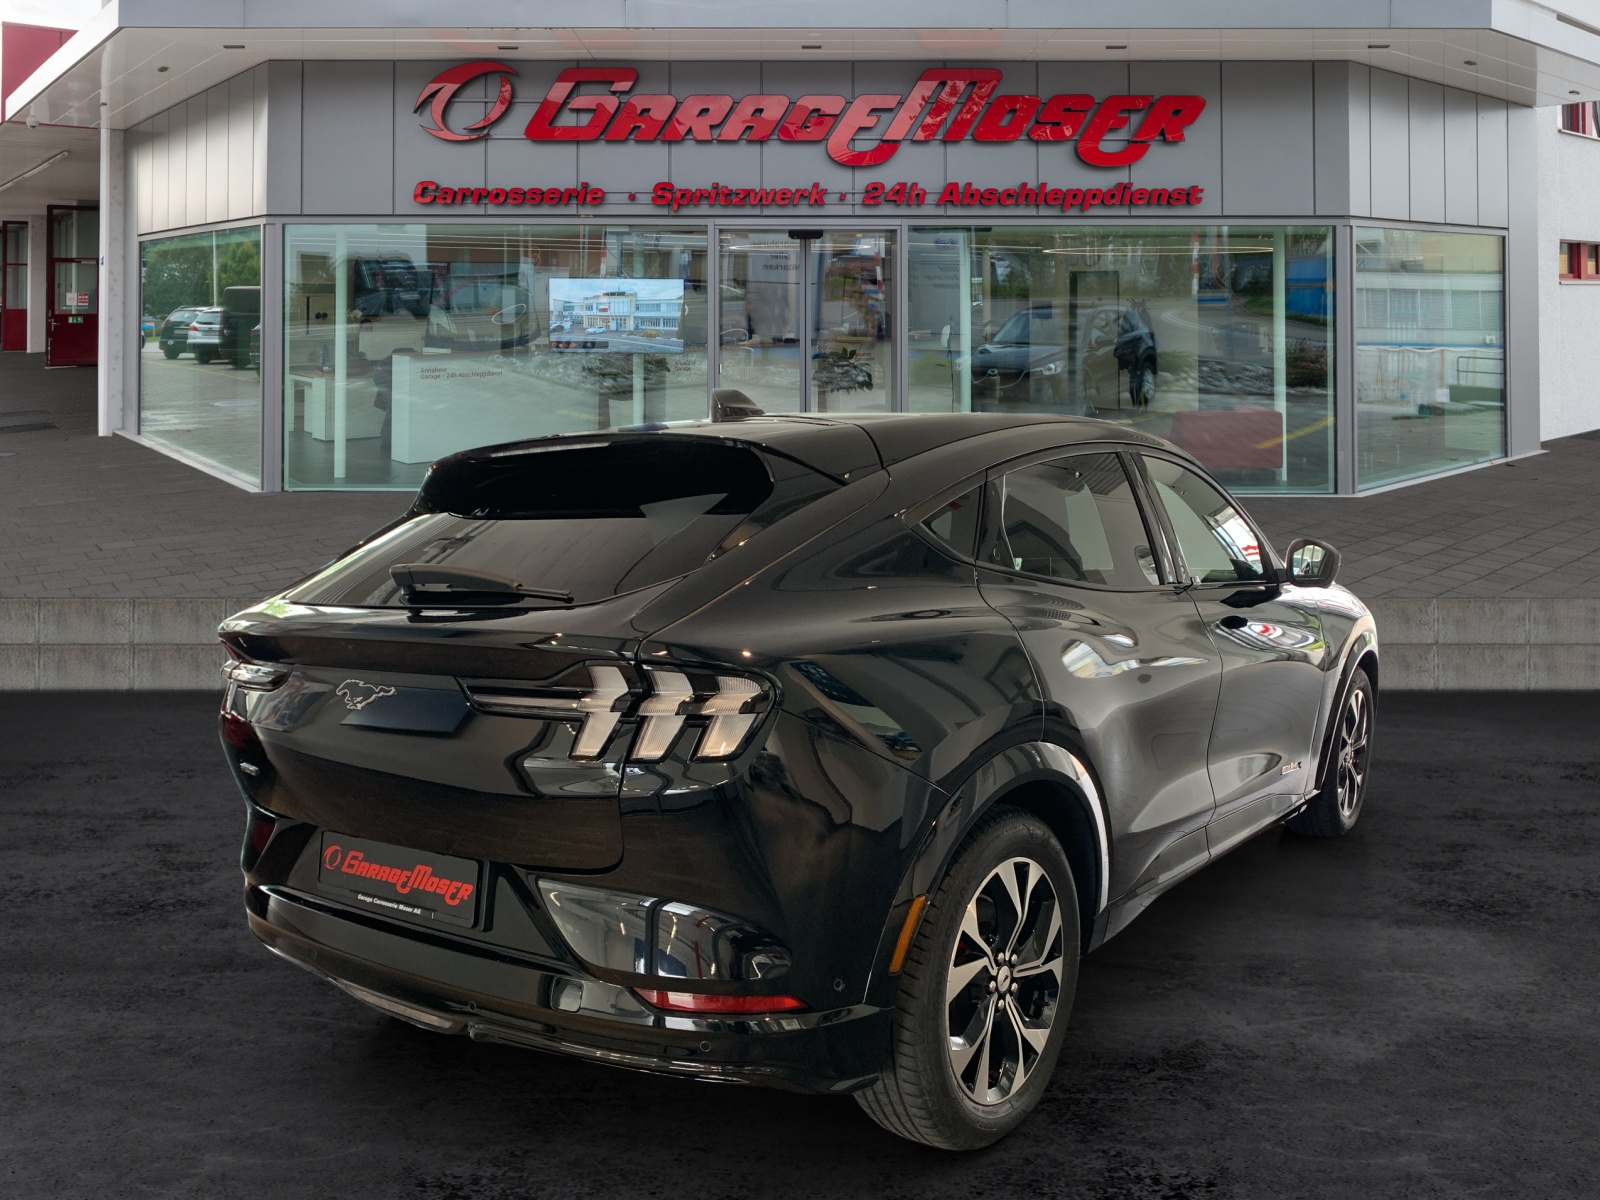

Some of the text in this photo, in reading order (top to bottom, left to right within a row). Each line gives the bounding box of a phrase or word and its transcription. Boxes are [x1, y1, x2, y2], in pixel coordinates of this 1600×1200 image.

[413, 180, 1204, 212] Carrosserie Spritzwerk 24h Abschleppdienst
[420, 373, 441, 381] Garage
[458, 370, 503, 379] Abschleppdienst
[357, 893, 373, 903] Garage
[398, 903, 413, 913] Moser
[412, 907, 422, 915] AG
